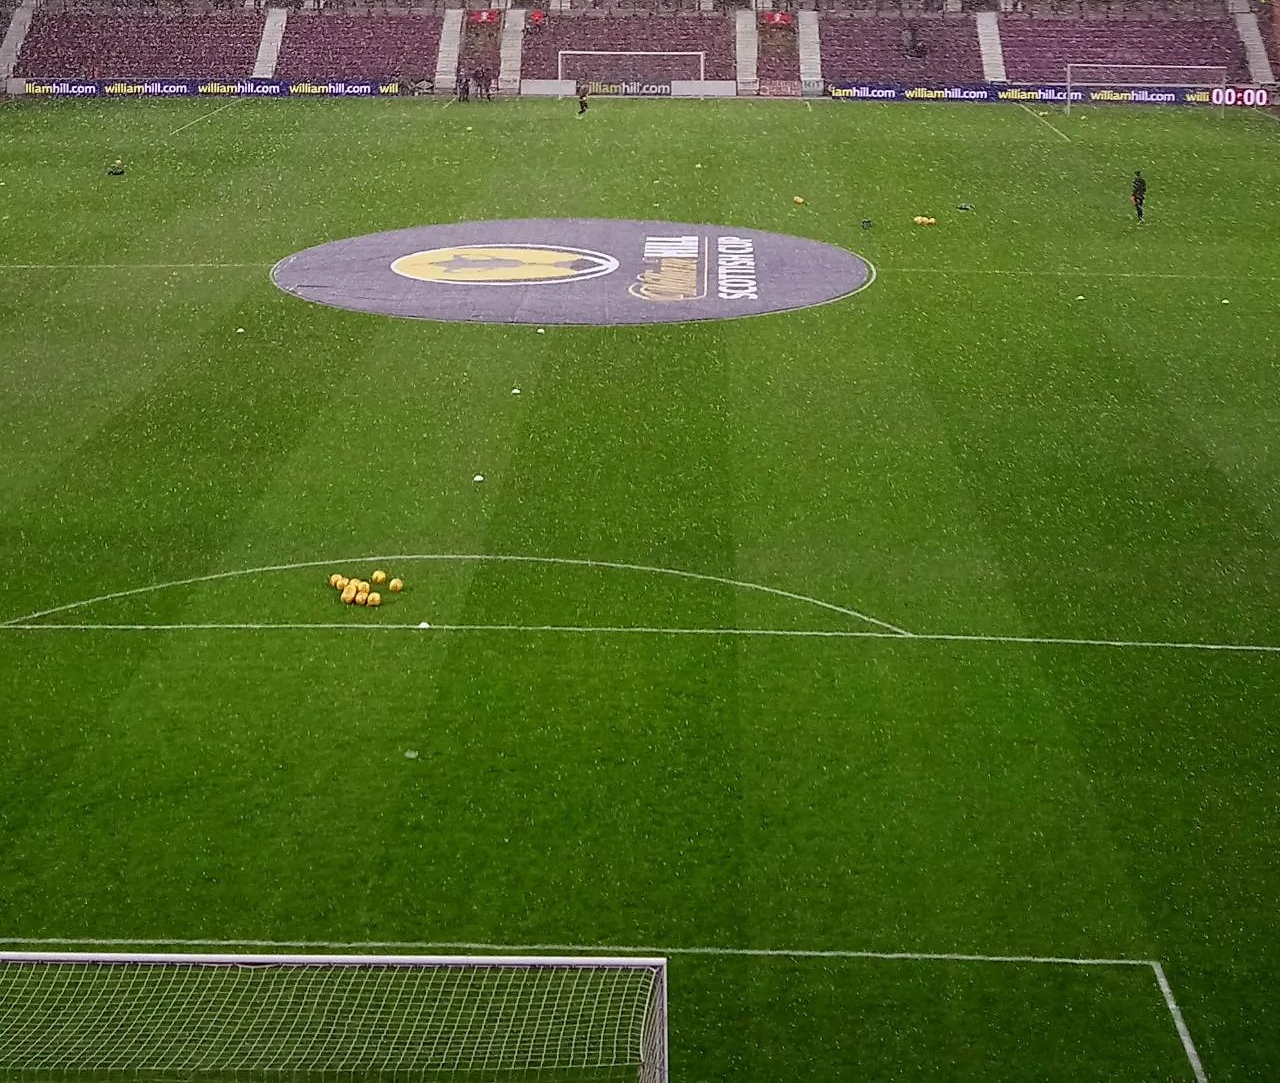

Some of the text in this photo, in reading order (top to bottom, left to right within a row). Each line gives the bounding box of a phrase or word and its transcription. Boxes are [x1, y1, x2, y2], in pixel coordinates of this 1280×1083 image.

[105, 82, 187, 94] williamhill.com
[198, 82, 279, 94] williamhill.com
[289, 82, 370, 94] williamhill.com
[379, 82, 399, 94] will
[584, 82, 670, 94] illiamhill.com
[904, 87, 988, 99] williamhill.com
[1090, 90, 1175, 101] williamhill.com
[1212, 89, 1267, 105] 00:00
[644, 236, 699, 257] HILL
[718, 236, 758, 300] SCOTTISH CUP
